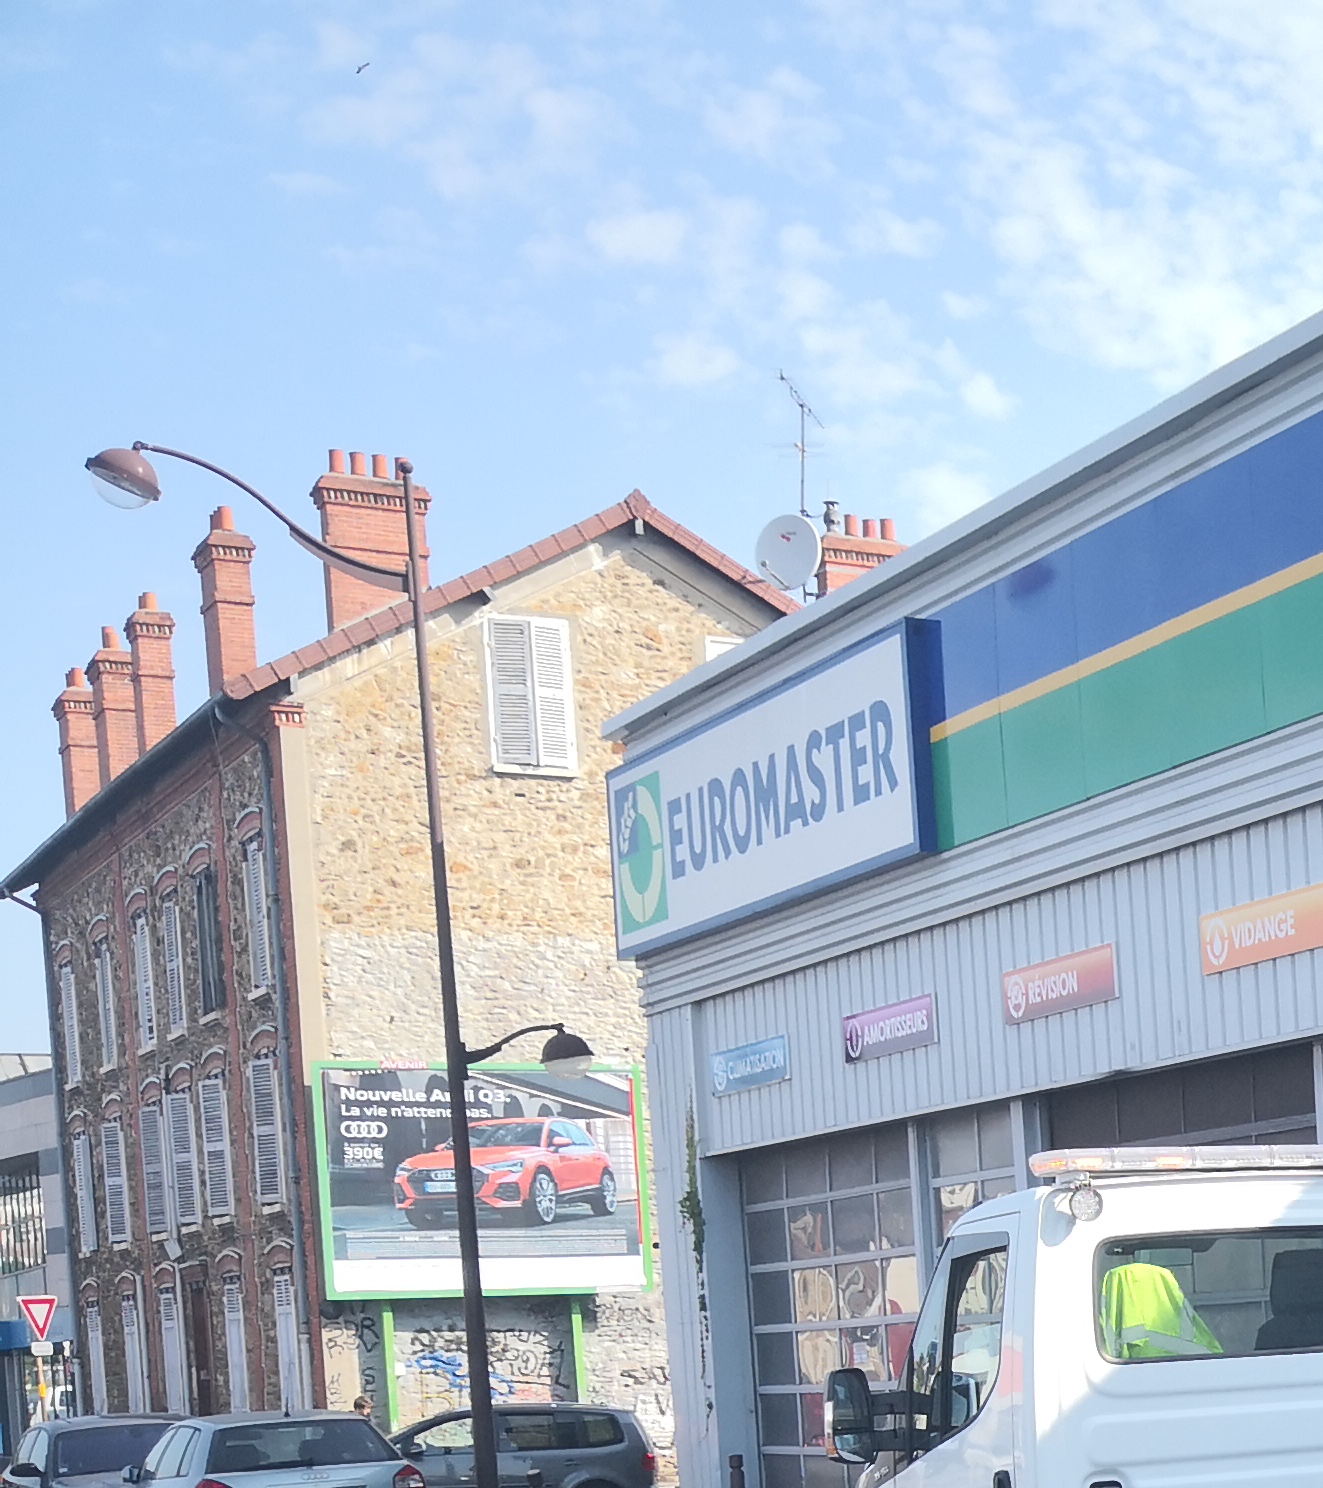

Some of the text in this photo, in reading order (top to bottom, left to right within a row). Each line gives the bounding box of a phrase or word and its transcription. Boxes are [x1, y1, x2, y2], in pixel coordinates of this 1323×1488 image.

[667, 700, 899, 880] EUROMASTER
[1231, 909, 1296, 949] VIDANGE
[1028, 969, 1078, 1005] RÉVISION
[863, 1009, 928, 1046] AMORTISSEURS
[380, 1060, 428, 1070] AVENIR
[340, 1087, 427, 1103] Nouvelle
[478, 1089, 511, 1105] Q3.
[341, 1104, 361, 1117] La
[363, 1105, 387, 1117] vie
[344, 1147, 384, 1160] 390€
